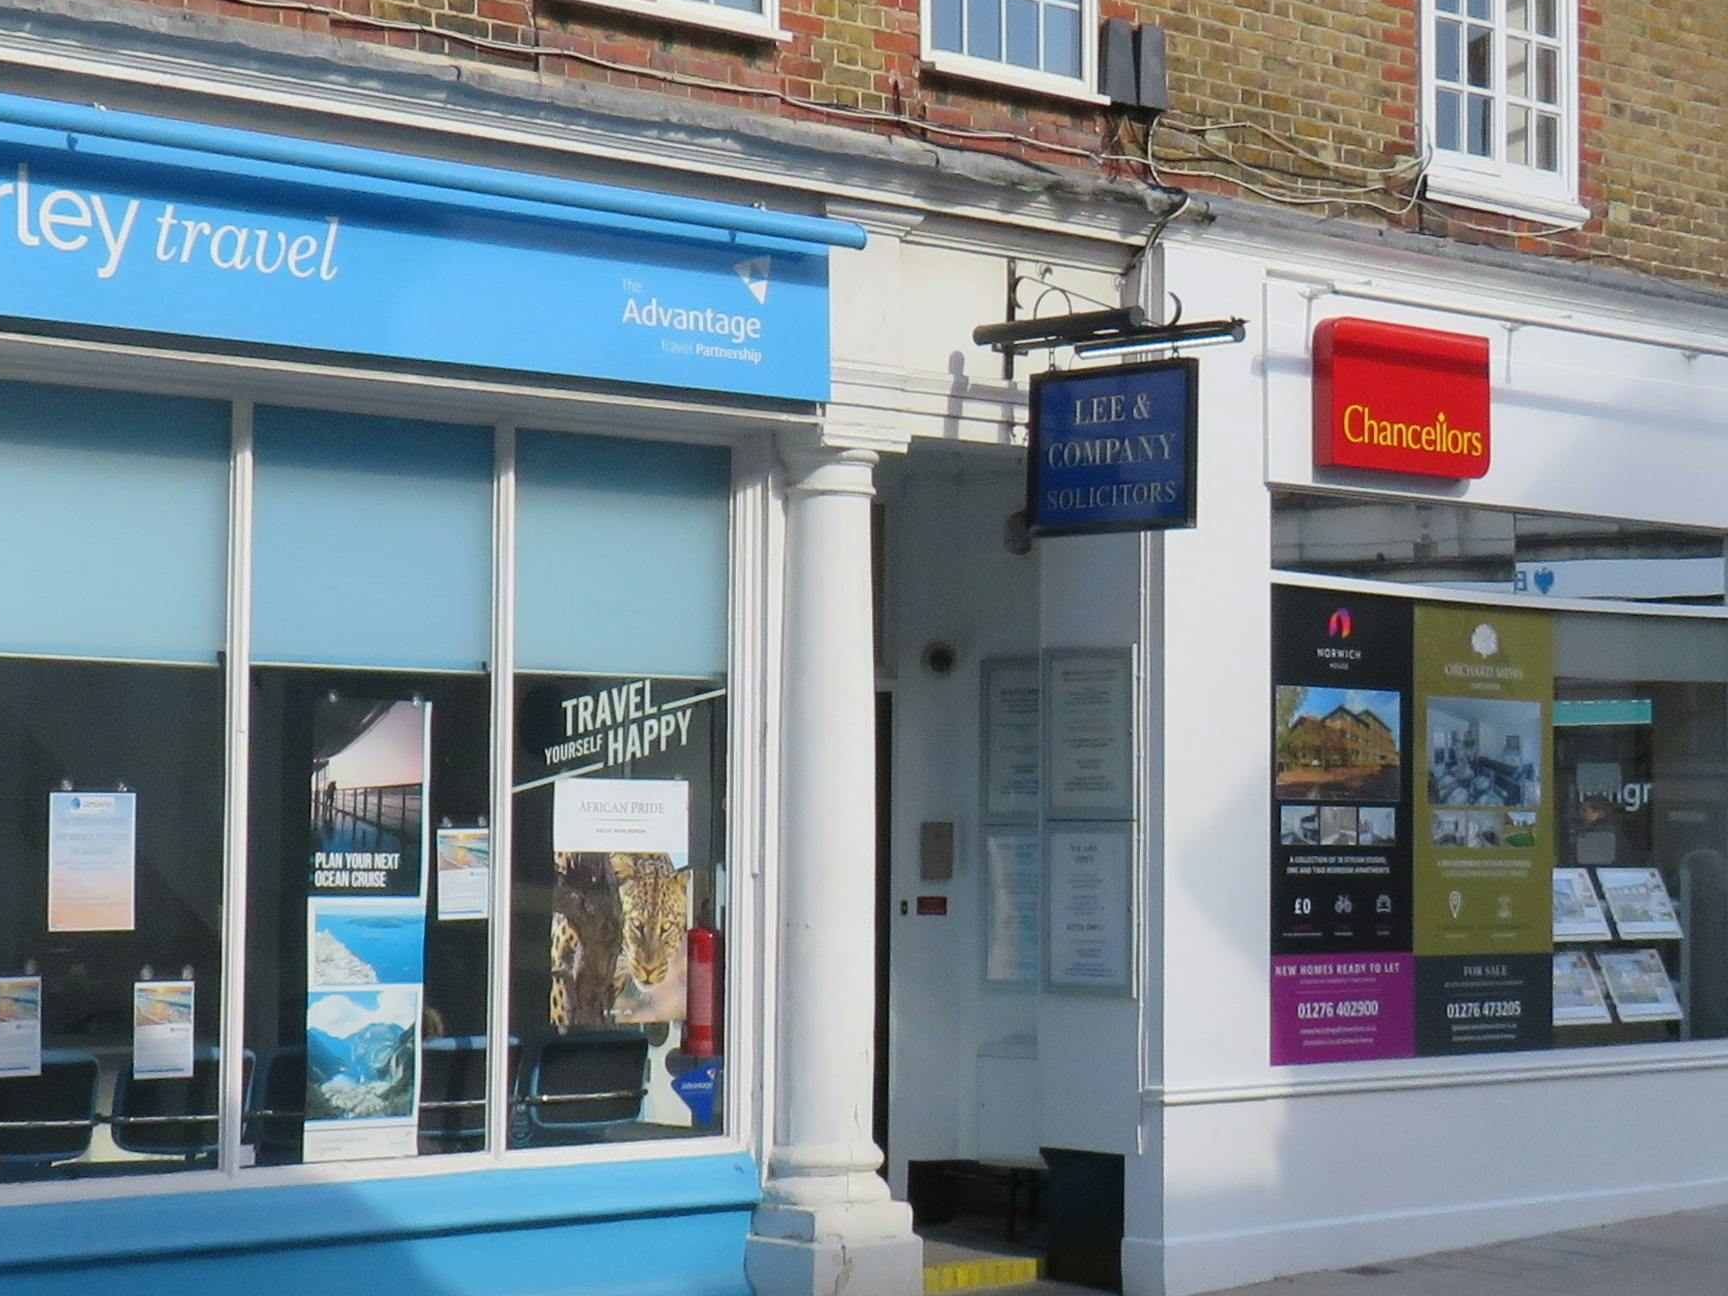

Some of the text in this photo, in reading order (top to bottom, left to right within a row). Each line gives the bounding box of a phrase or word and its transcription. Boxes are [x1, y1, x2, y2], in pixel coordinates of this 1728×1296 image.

[156, 204, 339, 281] travel
[622, 278, 642, 293] The
[622, 297, 762, 344] Advantage
[661, 339, 762, 365] Travel Partnership
[1074, 392, 1151, 425] LEE &
[1343, 404, 1483, 457] Chancellors
[1047, 433, 1176, 469] COMPANY
[1046, 480, 1176, 511] SOLICITORS
[1316, 647, 1362, 660] NORWICH
[561, 679, 658, 737] TRAVEL
[544, 707, 693, 767] YOURSELF HAPPY
[577, 800, 665, 816] AFRICAN PRIDE
[315, 851, 401, 870] PLAN YOUR NEXT
[314, 870, 387, 887] OCEAN CRUISE
[1294, 897, 1312, 915] £0
[1274, 962, 1401, 977] NEW HOMES READY TO LET
[1463, 964, 1509, 977] FOR SALE
[1297, 999, 1379, 1019] 01276 402900
[1446, 1000, 1522, 1019] 01276 473205
